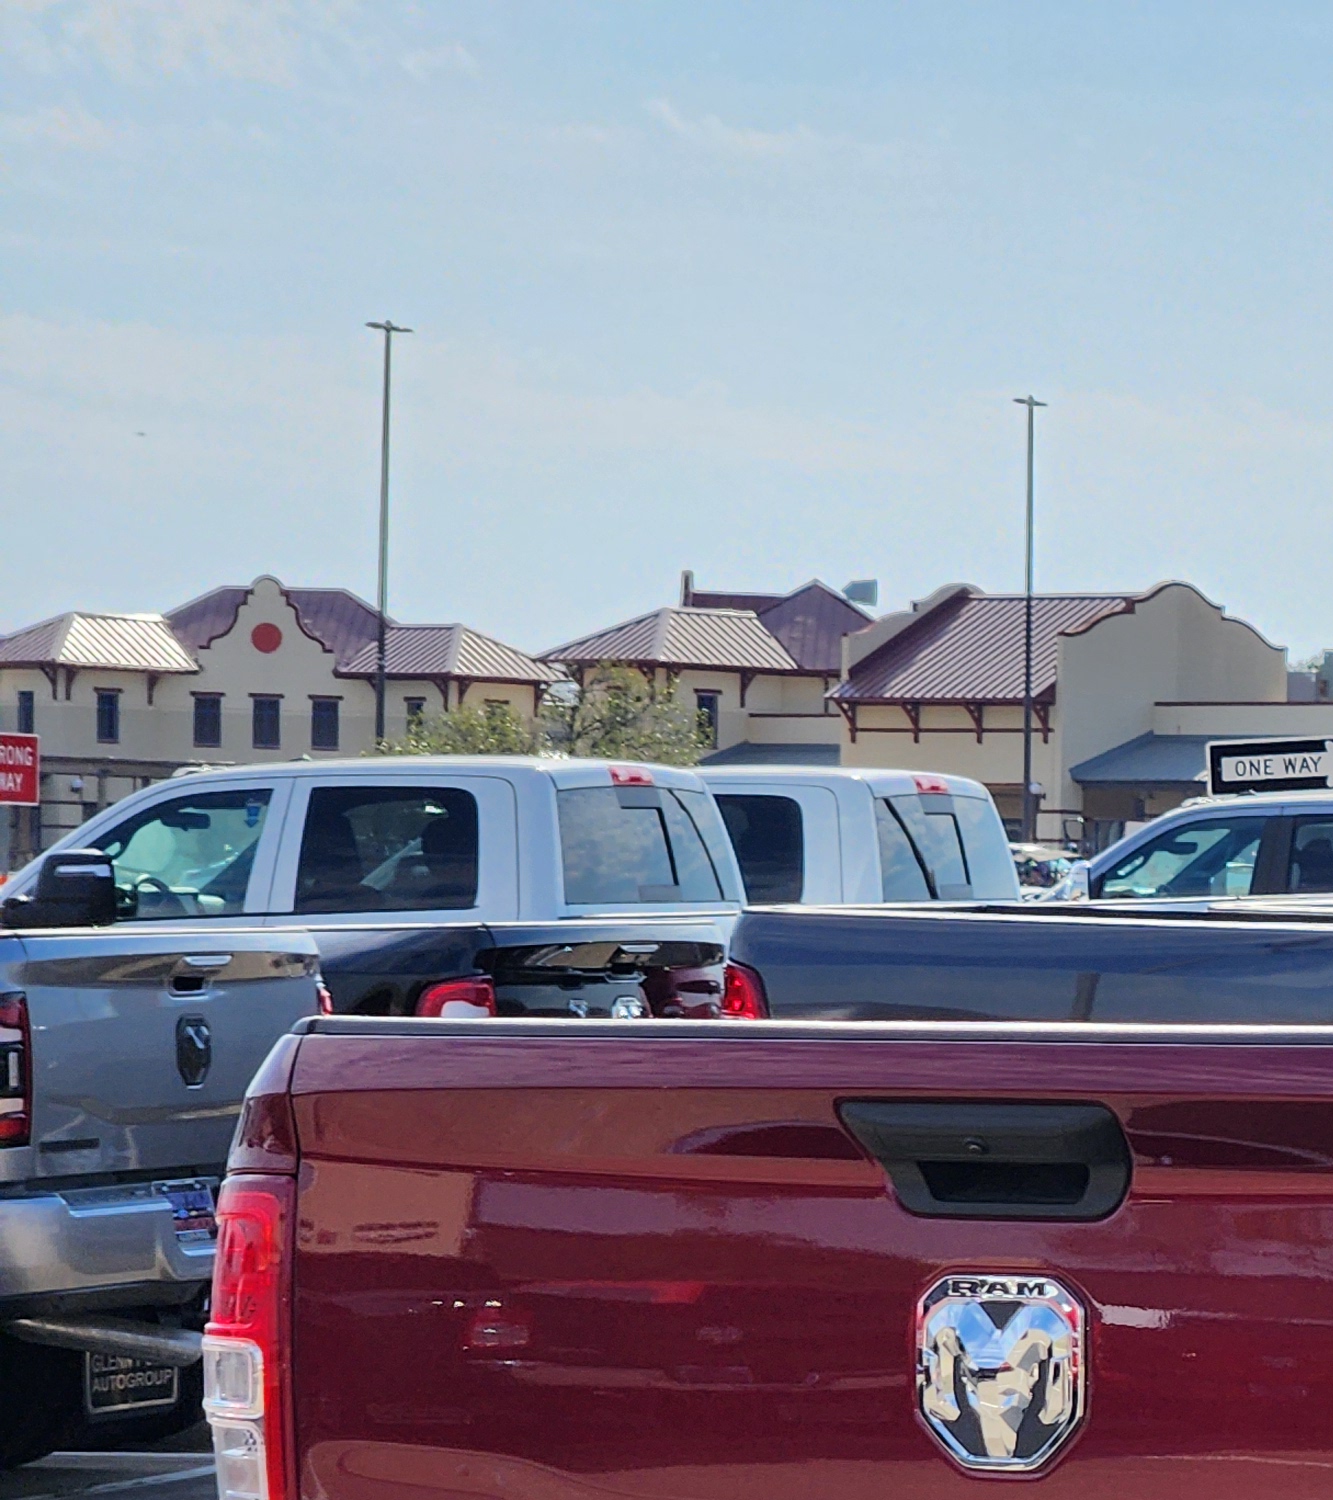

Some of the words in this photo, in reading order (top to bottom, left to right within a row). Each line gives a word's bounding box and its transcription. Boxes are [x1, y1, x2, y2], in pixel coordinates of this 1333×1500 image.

[0, 745, 33, 766] RONG
[1234, 758, 1275, 777] ONE
[1283, 756, 1323, 774] WAY
[950, 1278, 1048, 1298] RAM
[92, 1369, 173, 1392] AUTOGROUP
